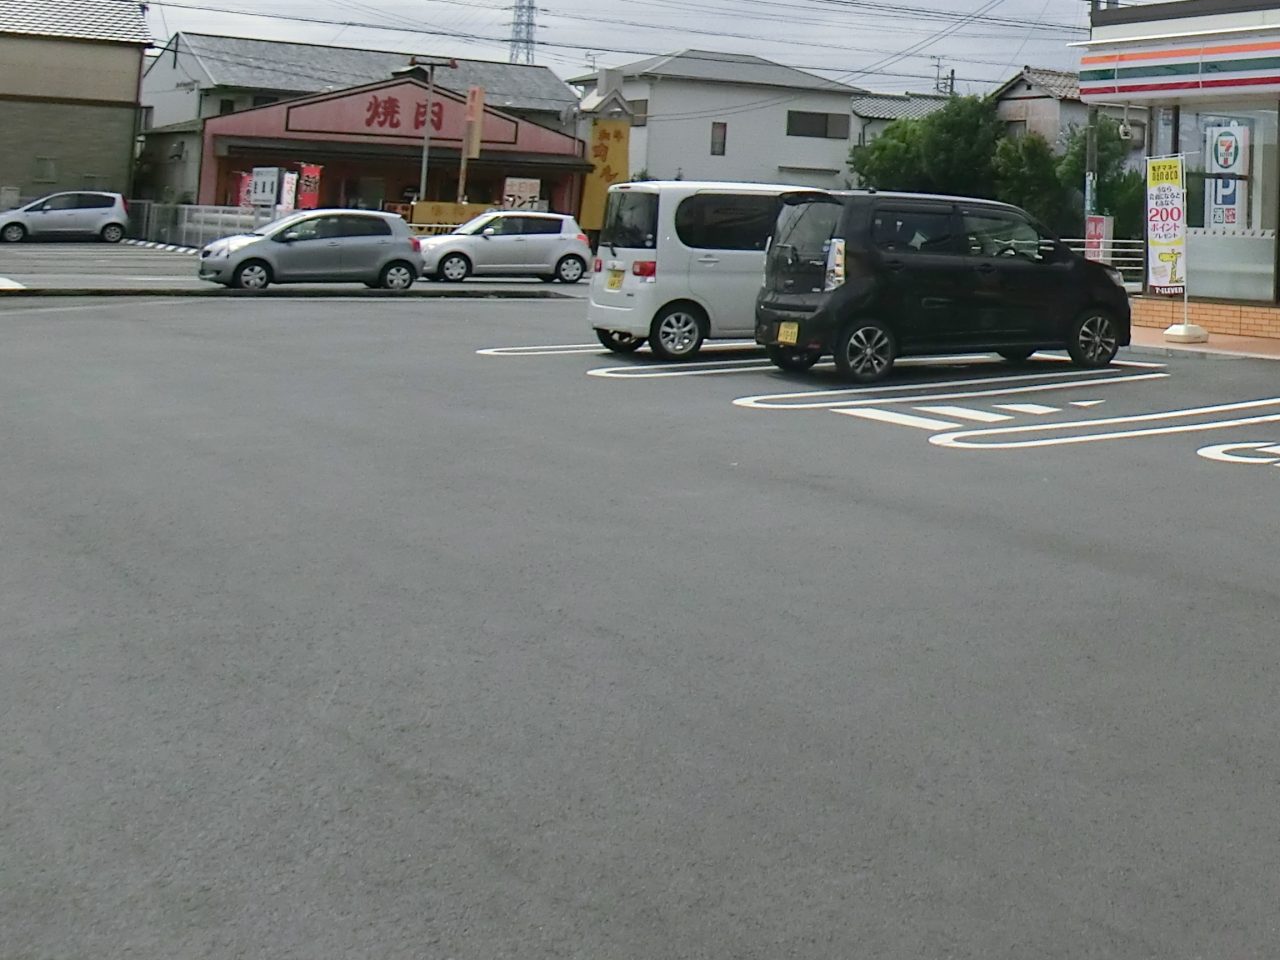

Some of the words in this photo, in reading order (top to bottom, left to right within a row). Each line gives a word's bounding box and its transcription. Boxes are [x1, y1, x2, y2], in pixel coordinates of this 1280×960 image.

[365, 94, 444, 131] 焼肉
[1149, 207, 1182, 222] 200
[1151, 223, 1180, 233] ポイント
